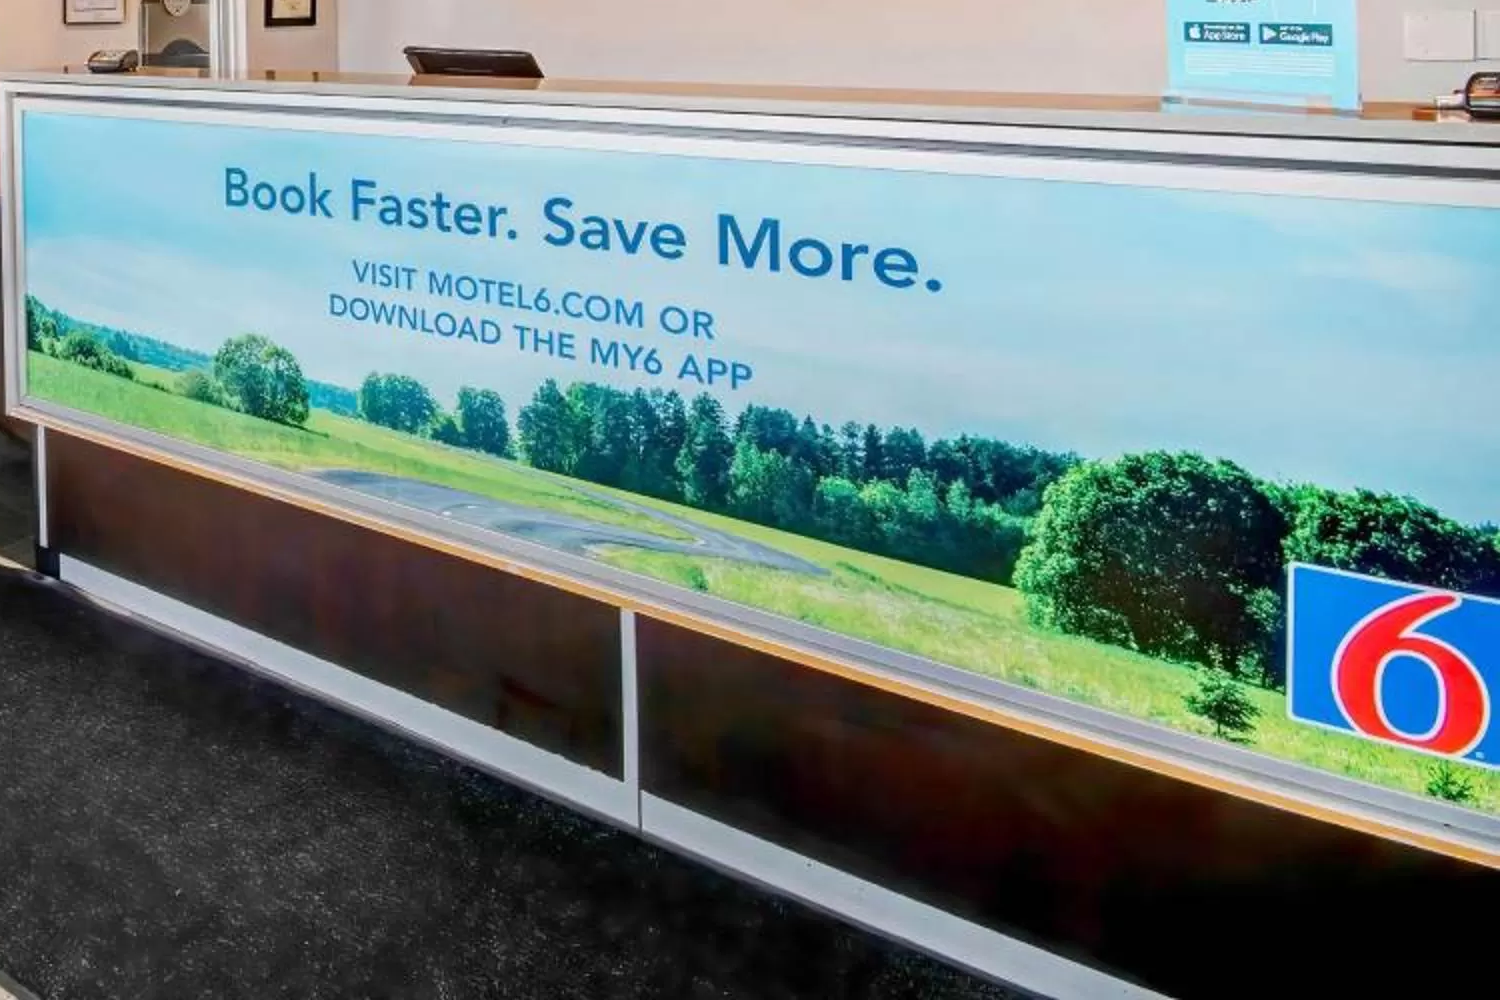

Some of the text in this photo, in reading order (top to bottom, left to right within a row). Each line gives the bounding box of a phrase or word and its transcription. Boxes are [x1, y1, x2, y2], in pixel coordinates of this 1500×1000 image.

[224, 167, 943, 293] Book Faster. Save More.
[329, 293, 753, 390] DOWNLOAD THE MY6 APP
[351, 259, 716, 340] VISIT MOTEL6.COM OR
[1330, 591, 1491, 759] 6
